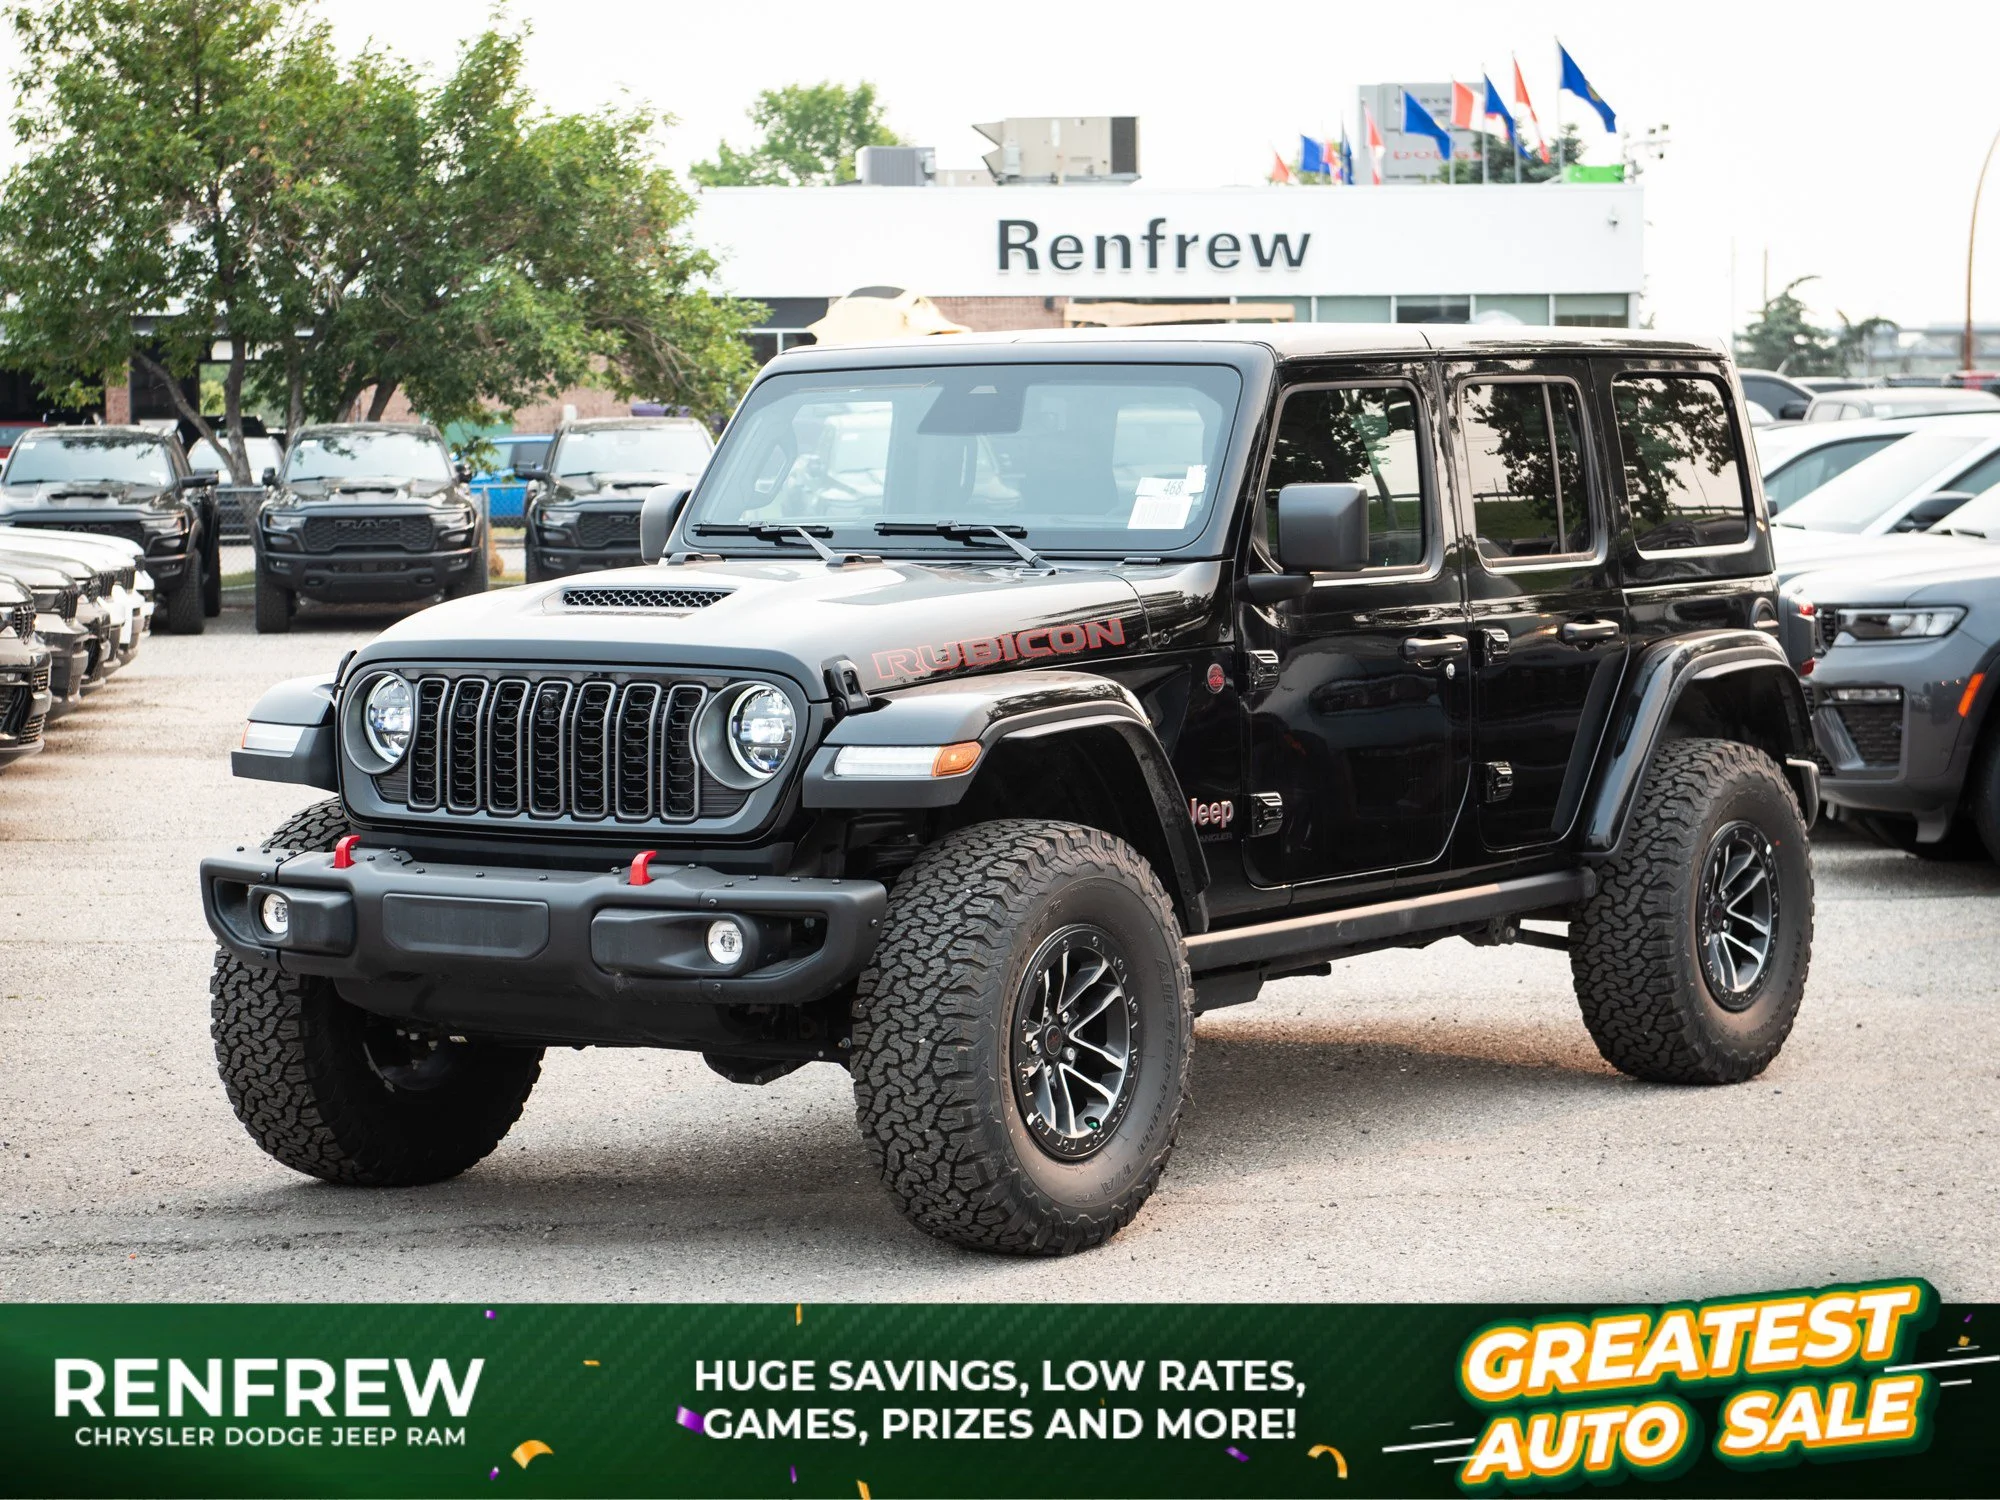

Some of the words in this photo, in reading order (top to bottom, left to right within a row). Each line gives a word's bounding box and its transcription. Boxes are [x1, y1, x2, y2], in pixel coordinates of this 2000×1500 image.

[998, 217, 1311, 271] Renfrew
[872, 618, 1126, 679] RUBICON
[1190, 797, 1235, 829] Jeep
